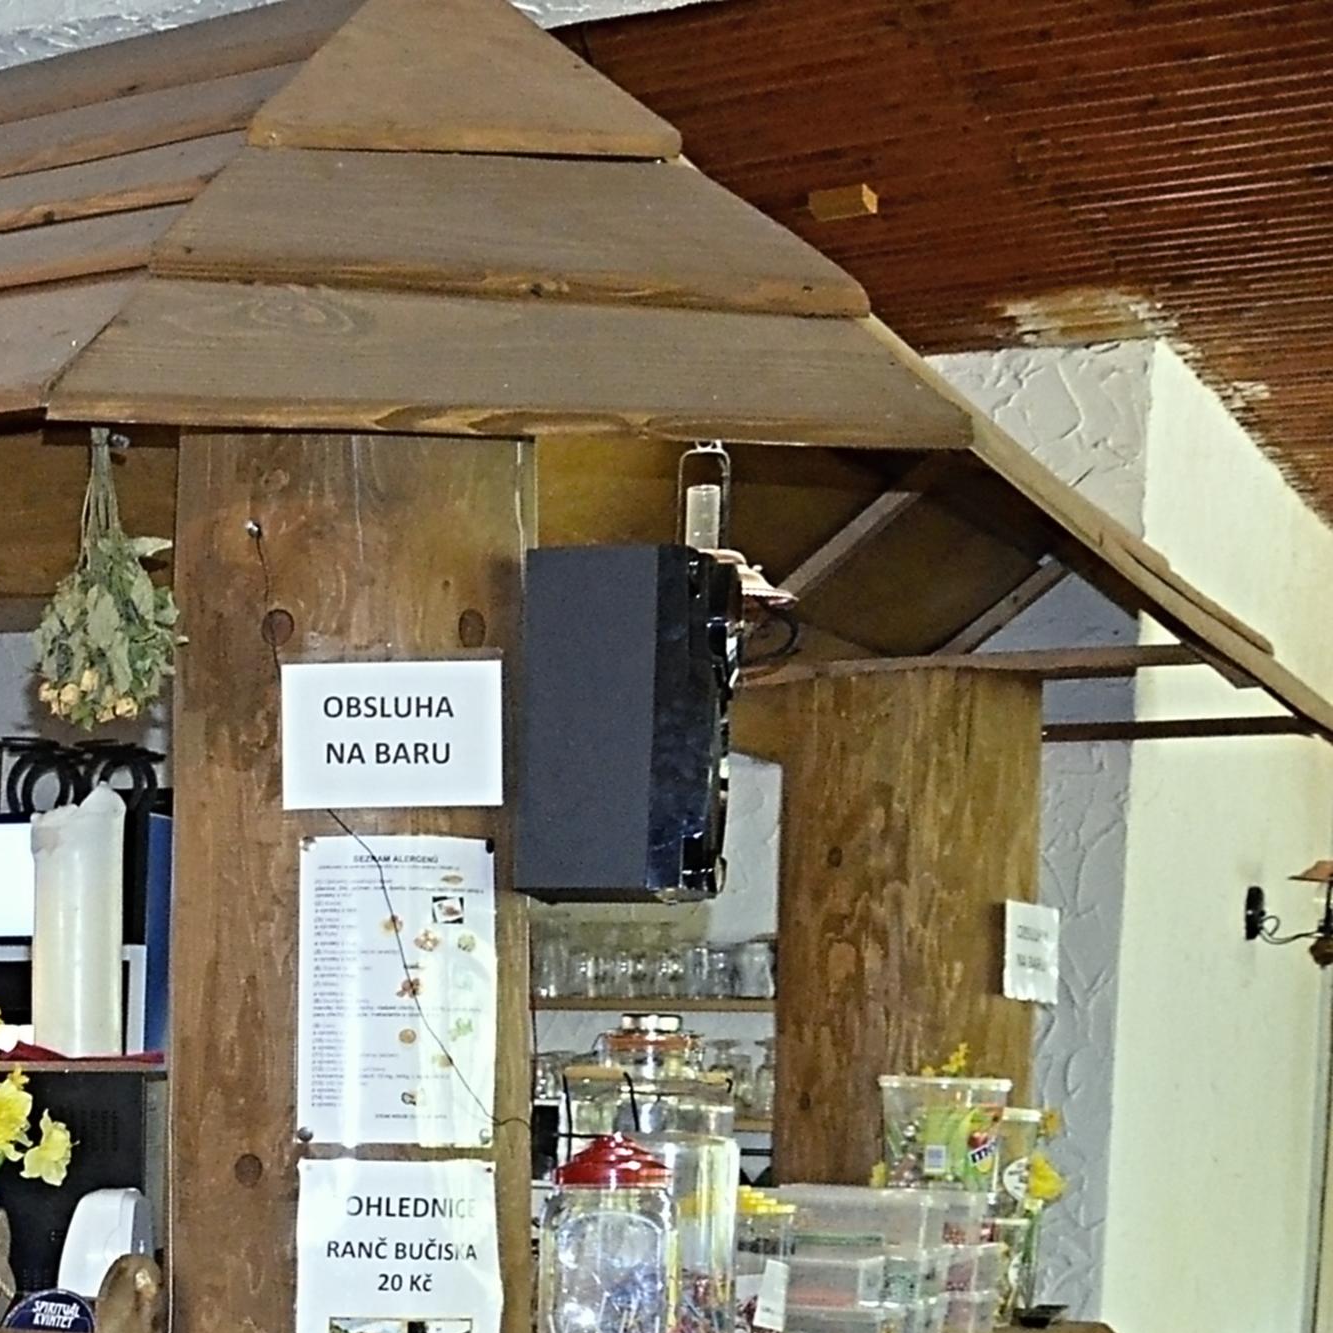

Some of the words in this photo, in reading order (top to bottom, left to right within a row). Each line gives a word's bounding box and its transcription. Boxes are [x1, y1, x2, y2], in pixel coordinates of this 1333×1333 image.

[323, 695, 454, 719] OBSLUHA
[326, 742, 366, 765] NA
[375, 742, 450, 765] BARU
[346, 1195, 476, 1219] OHLEDNICE
[326, 1237, 388, 1260] RANČ
[394, 1238, 478, 1261] BUČISKA
[377, 1273, 403, 1292] 20
[409, 1273, 434, 1292] Kč
